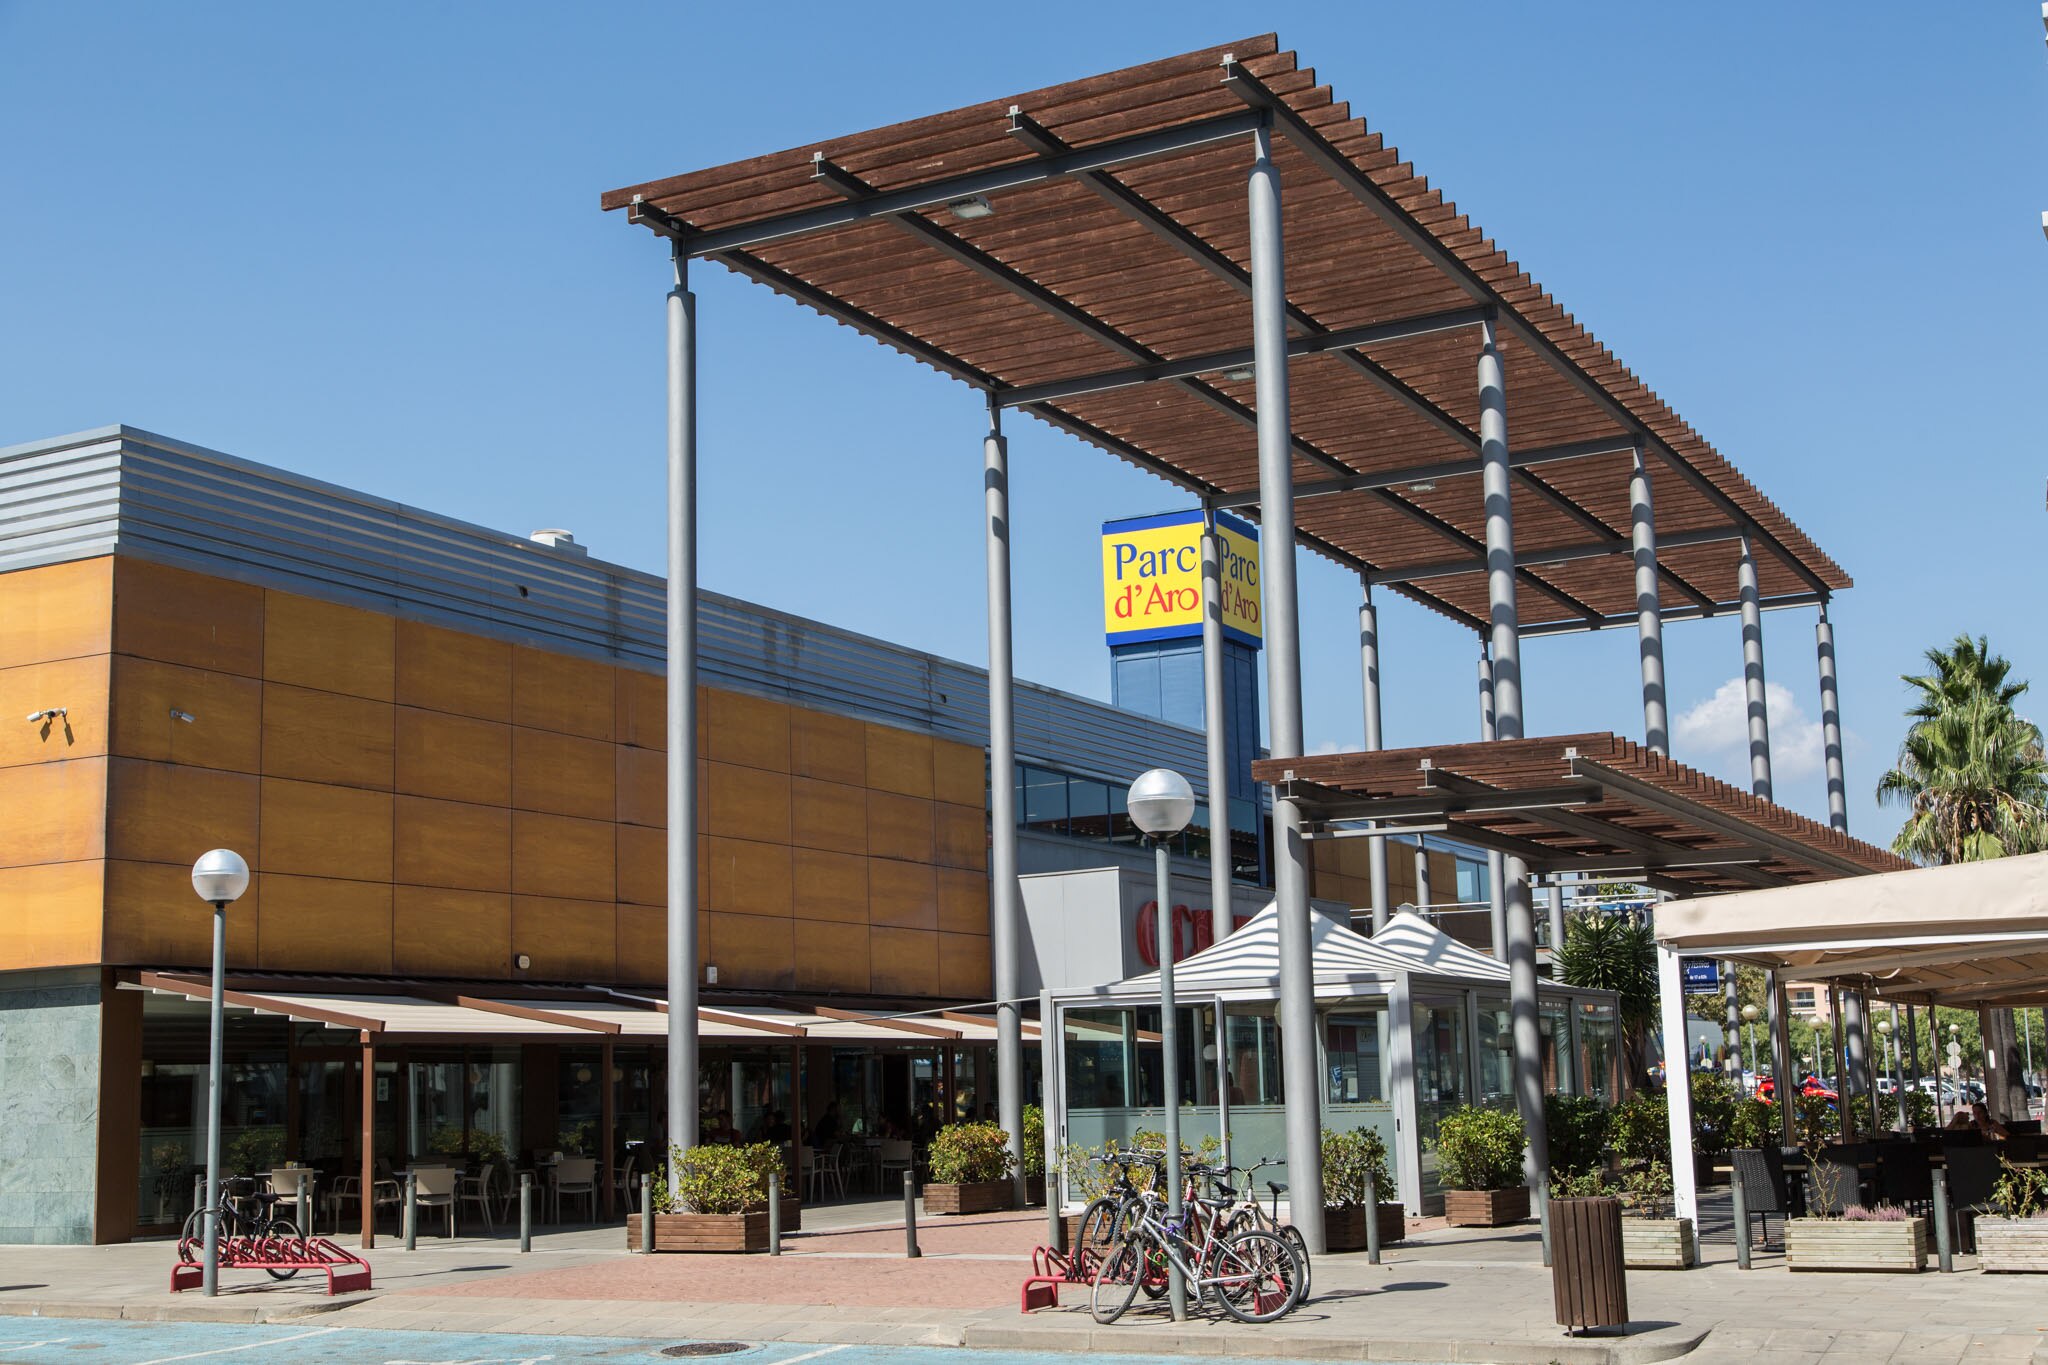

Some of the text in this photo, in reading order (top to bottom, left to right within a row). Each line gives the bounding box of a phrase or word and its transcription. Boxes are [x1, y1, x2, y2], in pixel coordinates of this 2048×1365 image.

[1112, 543, 1197, 581] Parc
[1218, 536, 1257, 586] Parc
[1114, 582, 1199, 619] d'Aro
[1220, 580, 1259, 624] d'Aro
